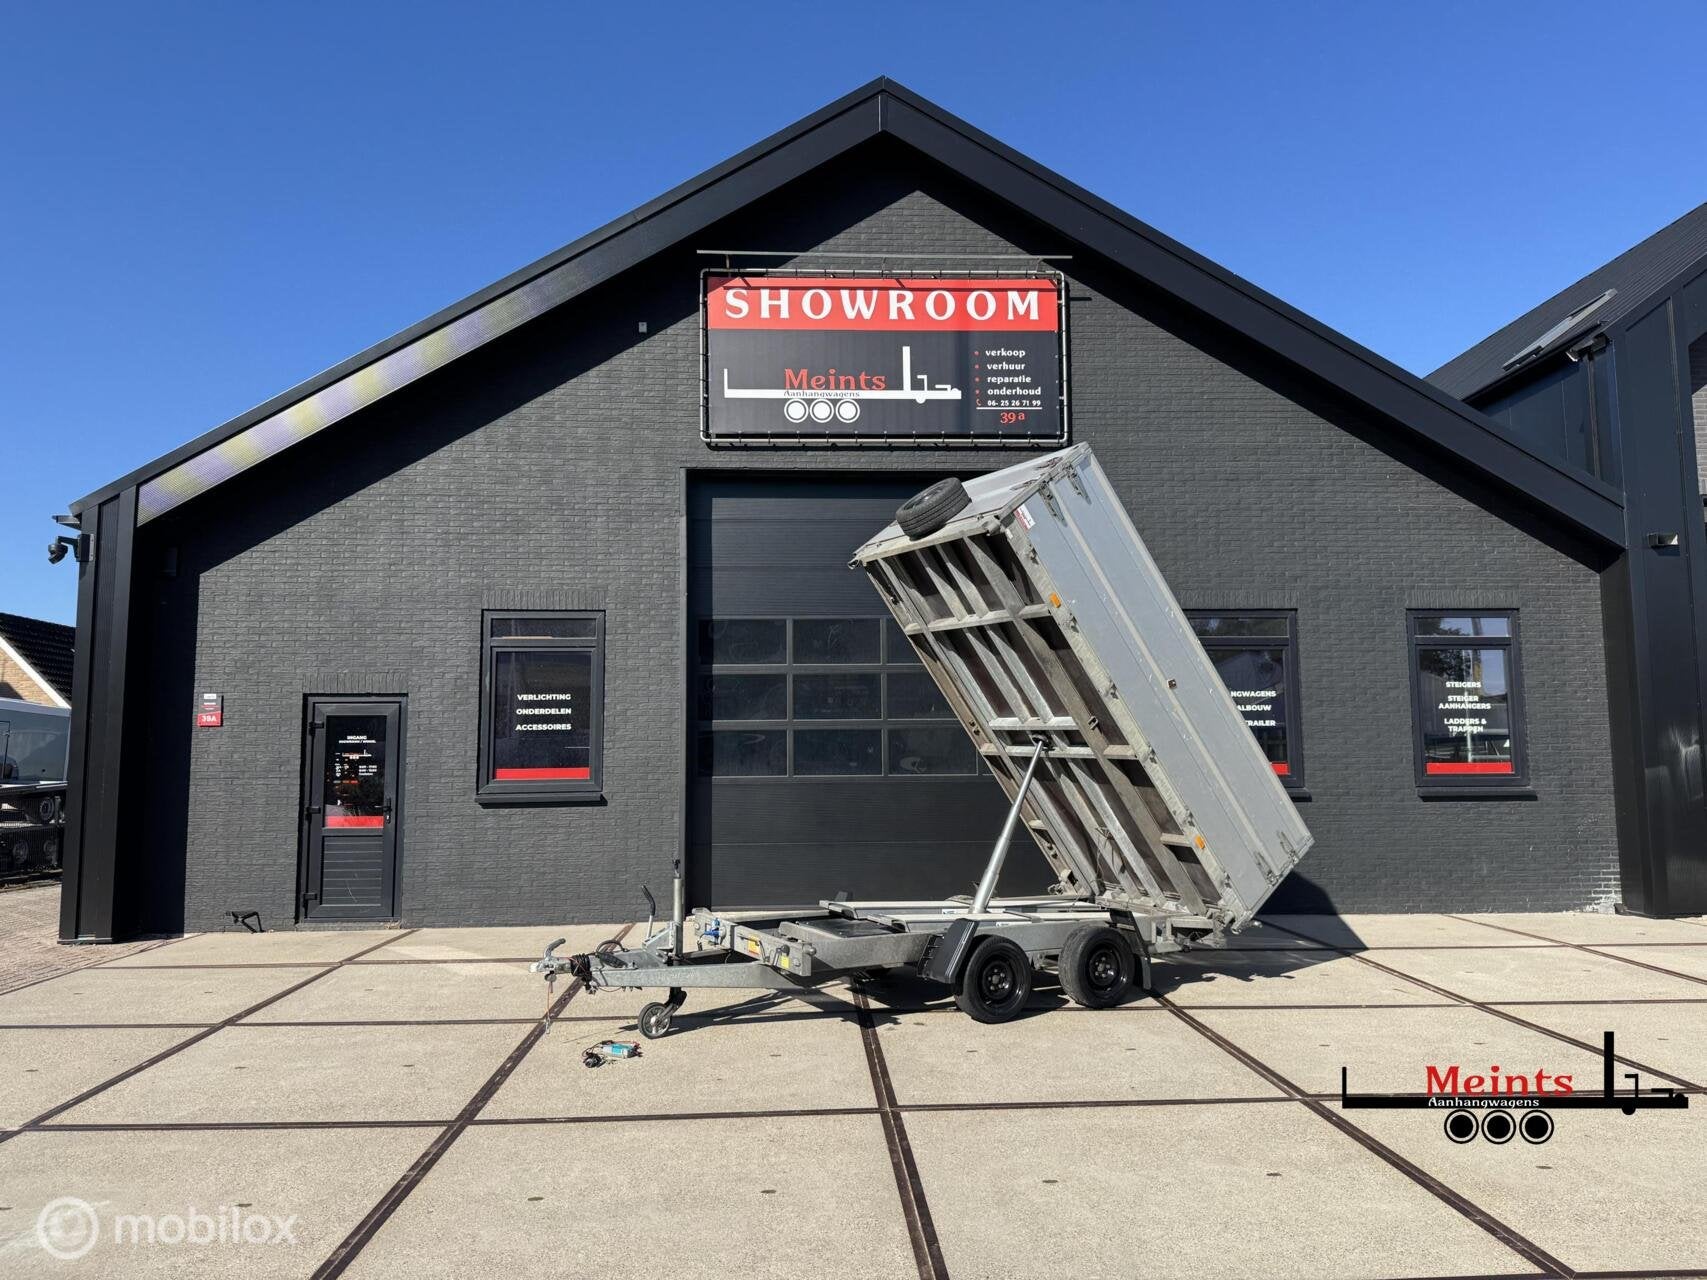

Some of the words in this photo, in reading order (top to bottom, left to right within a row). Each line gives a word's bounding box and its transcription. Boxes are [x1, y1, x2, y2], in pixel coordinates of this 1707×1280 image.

[725, 288, 1040, 320] SHOWROOM
[985, 348, 1026, 358] verkoop
[986, 361, 1026, 370] verhuur
[784, 367, 886, 391] Meints
[987, 375, 1032, 385] reparatie
[783, 390, 860, 398] Aanhangwagens
[987, 386, 1042, 396] onderhoud
